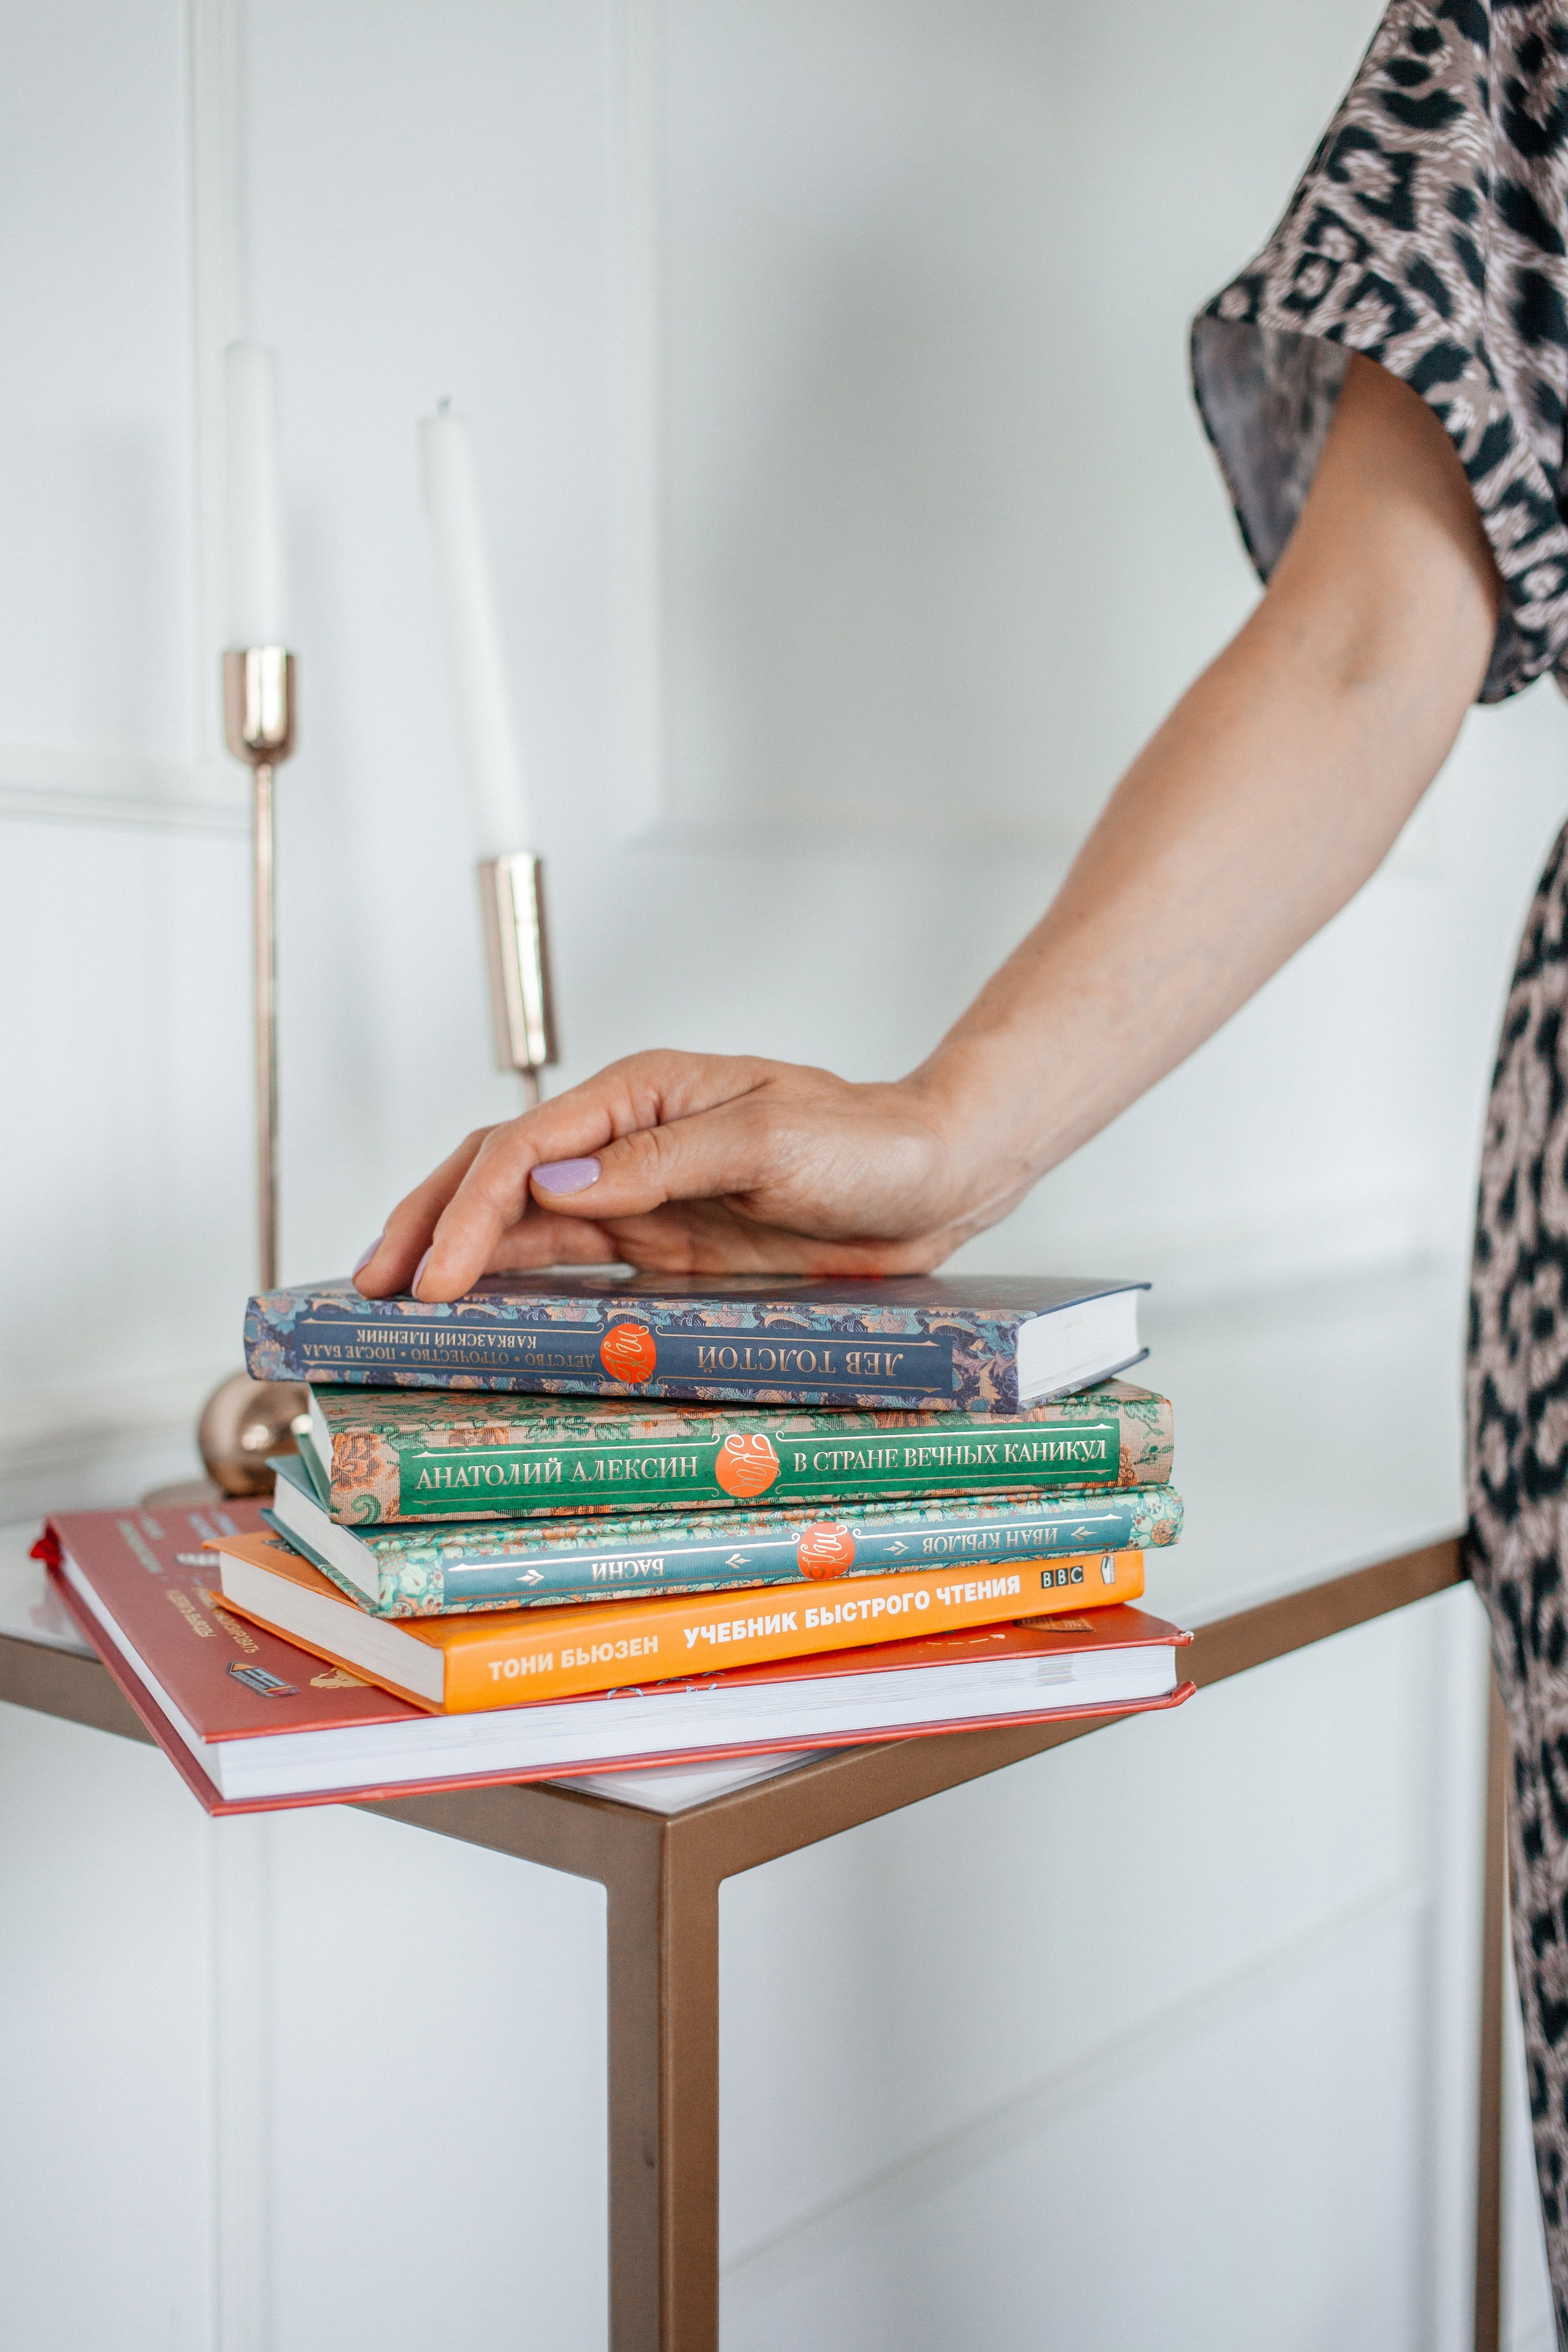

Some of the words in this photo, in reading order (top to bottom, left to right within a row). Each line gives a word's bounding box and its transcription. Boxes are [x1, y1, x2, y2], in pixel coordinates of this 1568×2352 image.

[356, 1328, 430, 1345] ПЛЕННИК
[434, 1331, 537, 1349] КАВКАЗСКИЙ
[302, 1343, 342, 1359] БАЛА
[345, 1345, 396, 1361] ПОСЛЕ
[411, 1348, 510, 1365] ОТРОЧЕСТВО
[525, 1352, 595, 1370] ДЕТСТВО
[697, 1345, 836, 1374] ТОЛСТОЙ
[846, 1352, 903, 1376] ЛЕВ
[793, 1452, 807, 1472] В
[813, 1448, 899, 1471] СТРАНЕ
[903, 1444, 998, 1468] ВЕЧНЫХ
[1003, 1439, 1107, 1463] КАНИКУЛ
[415, 1457, 563, 1490] АНАТОЛИЙ
[571, 1456, 698, 1482] АЛЕКСИН
[922, 1532, 1000, 1555] КРЫЛОВ
[1005, 1527, 1058, 1548] ИВАН
[591, 1558, 665, 1581] БАСНИ
[1041, 1565, 1084, 1589] BBC
[684, 1611, 798, 1648] УЧЕБНИК
[805, 1590, 930, 1628] БЫСТРОГО
[936, 1575, 1021, 1606] ЧТЕНИЯ
[488, 1652, 553, 1681] ТОНИ
[561, 1635, 659, 1669] БЬЮЗЕН
